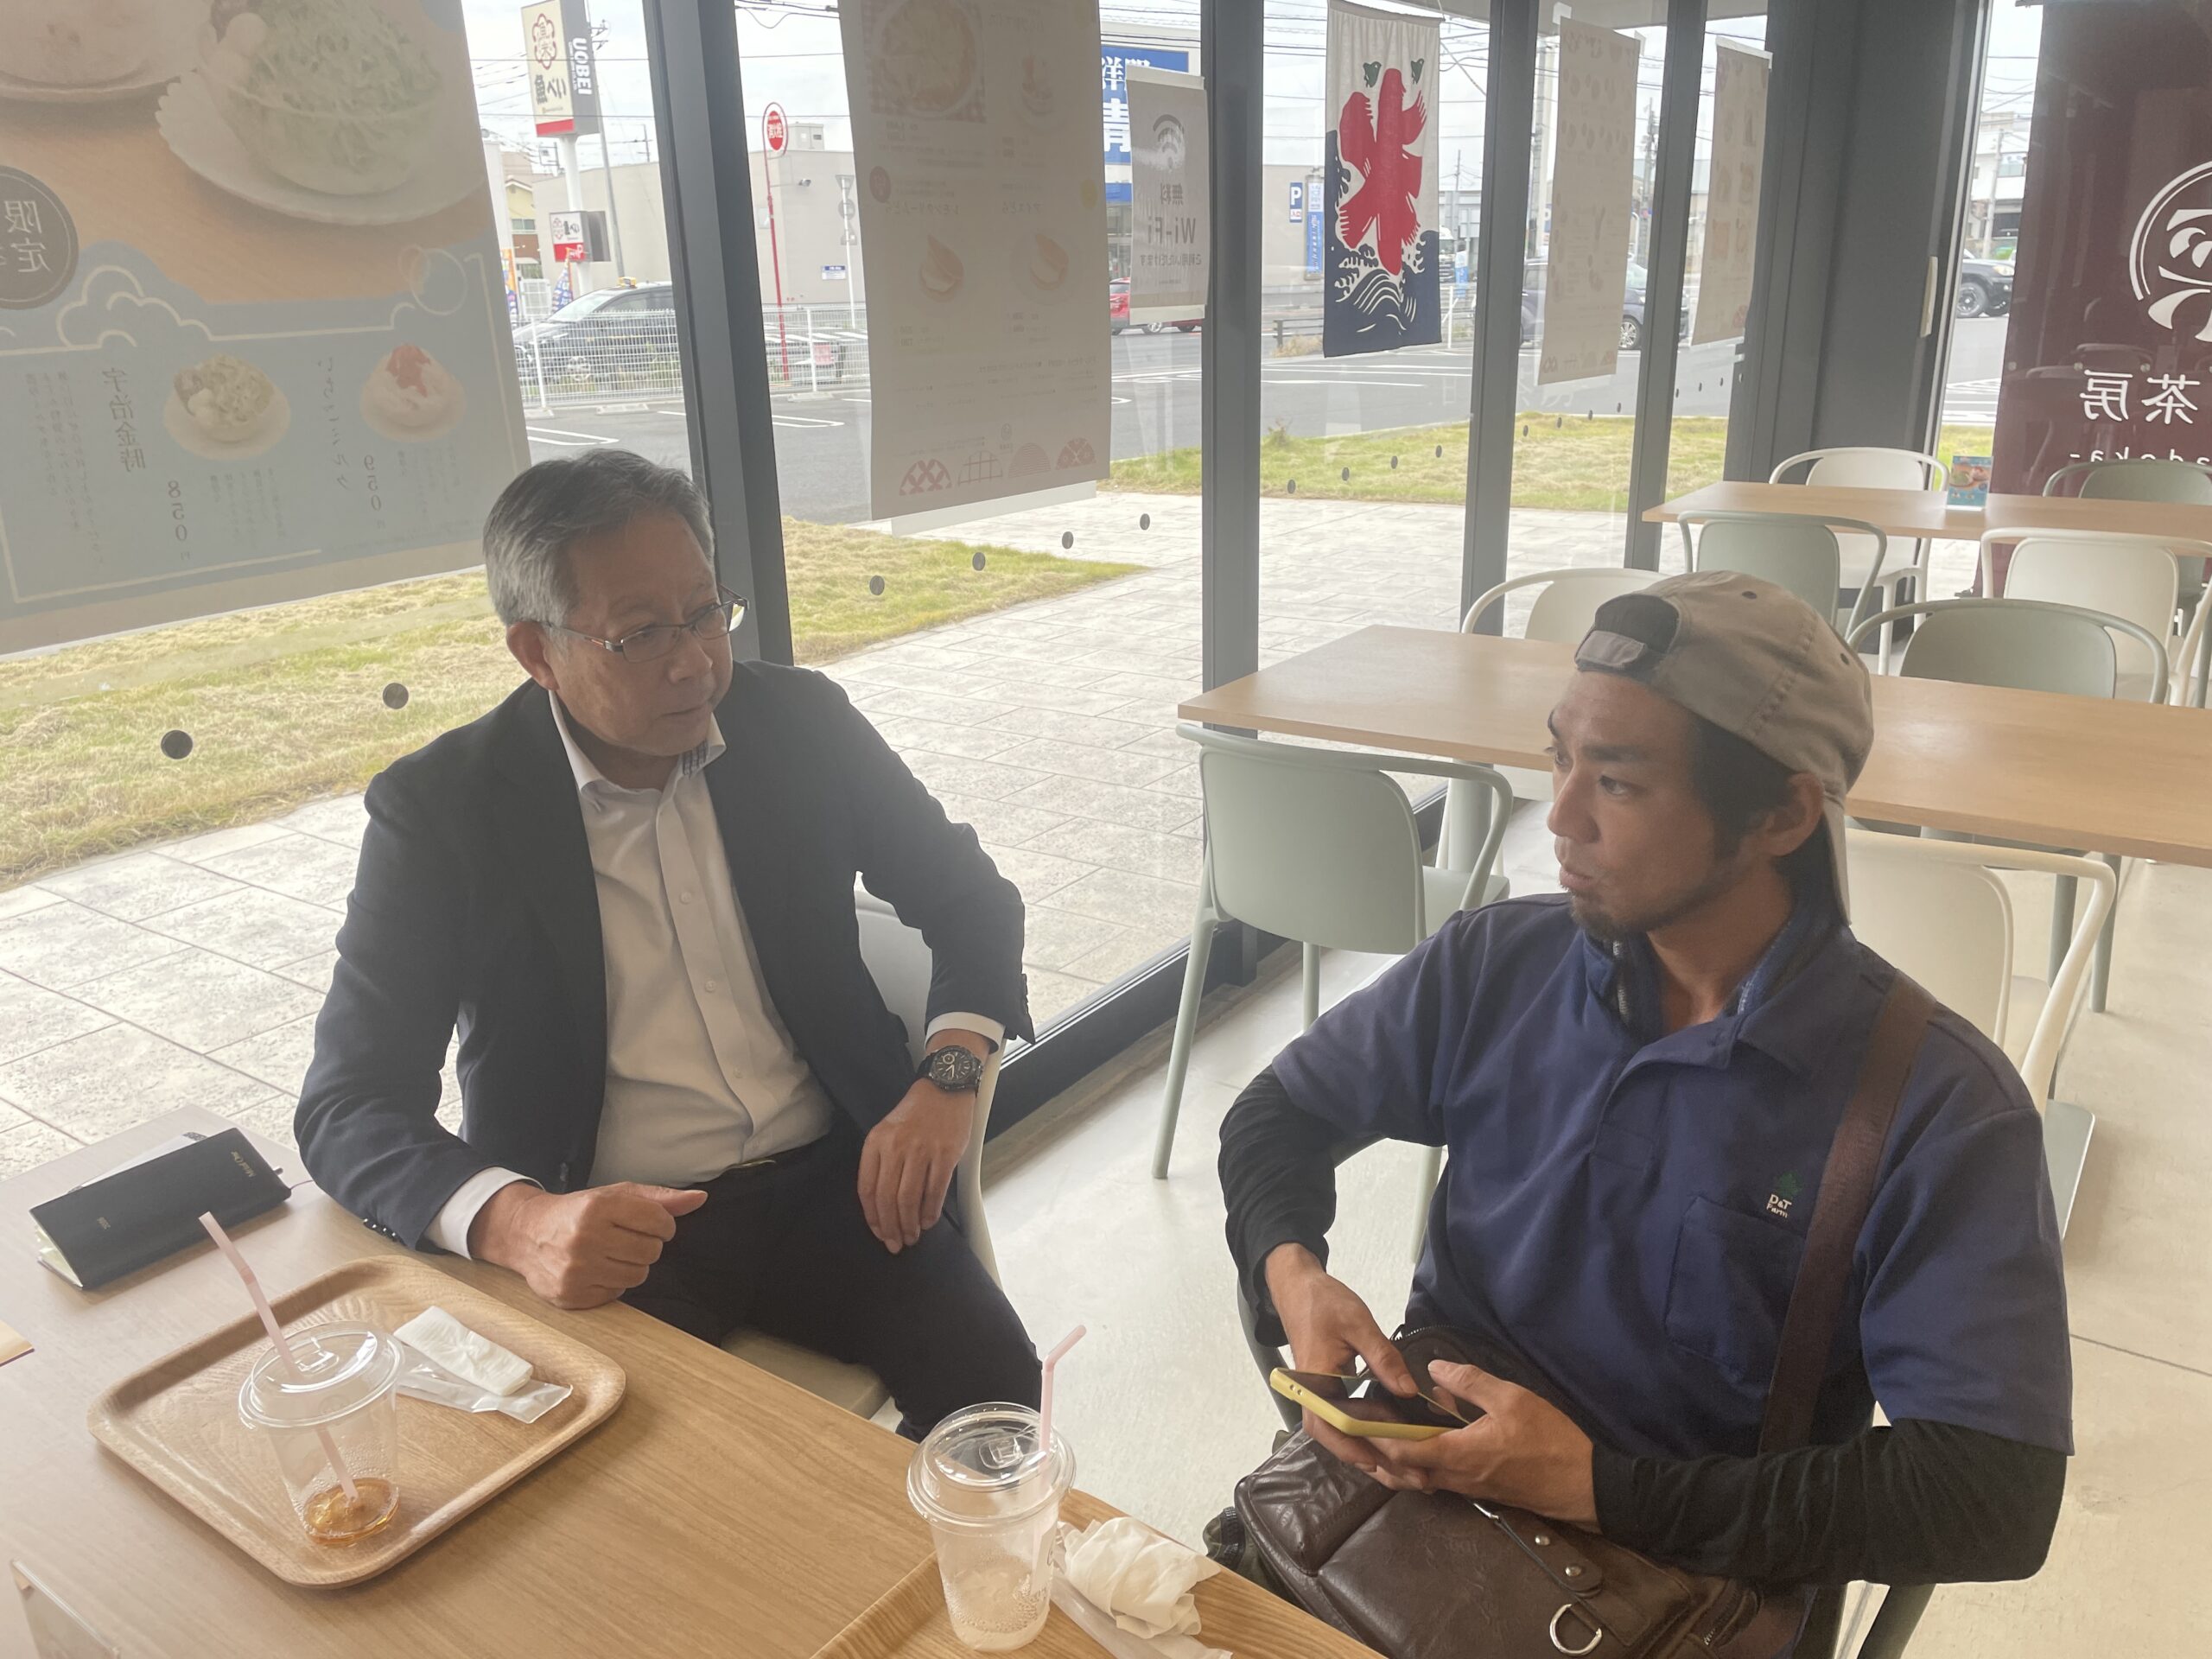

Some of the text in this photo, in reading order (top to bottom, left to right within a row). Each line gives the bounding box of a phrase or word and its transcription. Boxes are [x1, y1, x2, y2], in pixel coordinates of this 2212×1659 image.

[572, 37, 593, 96] UOBEI
[1291, 187, 1301, 207] P
[1769, 1193, 1792, 1210] D&T
